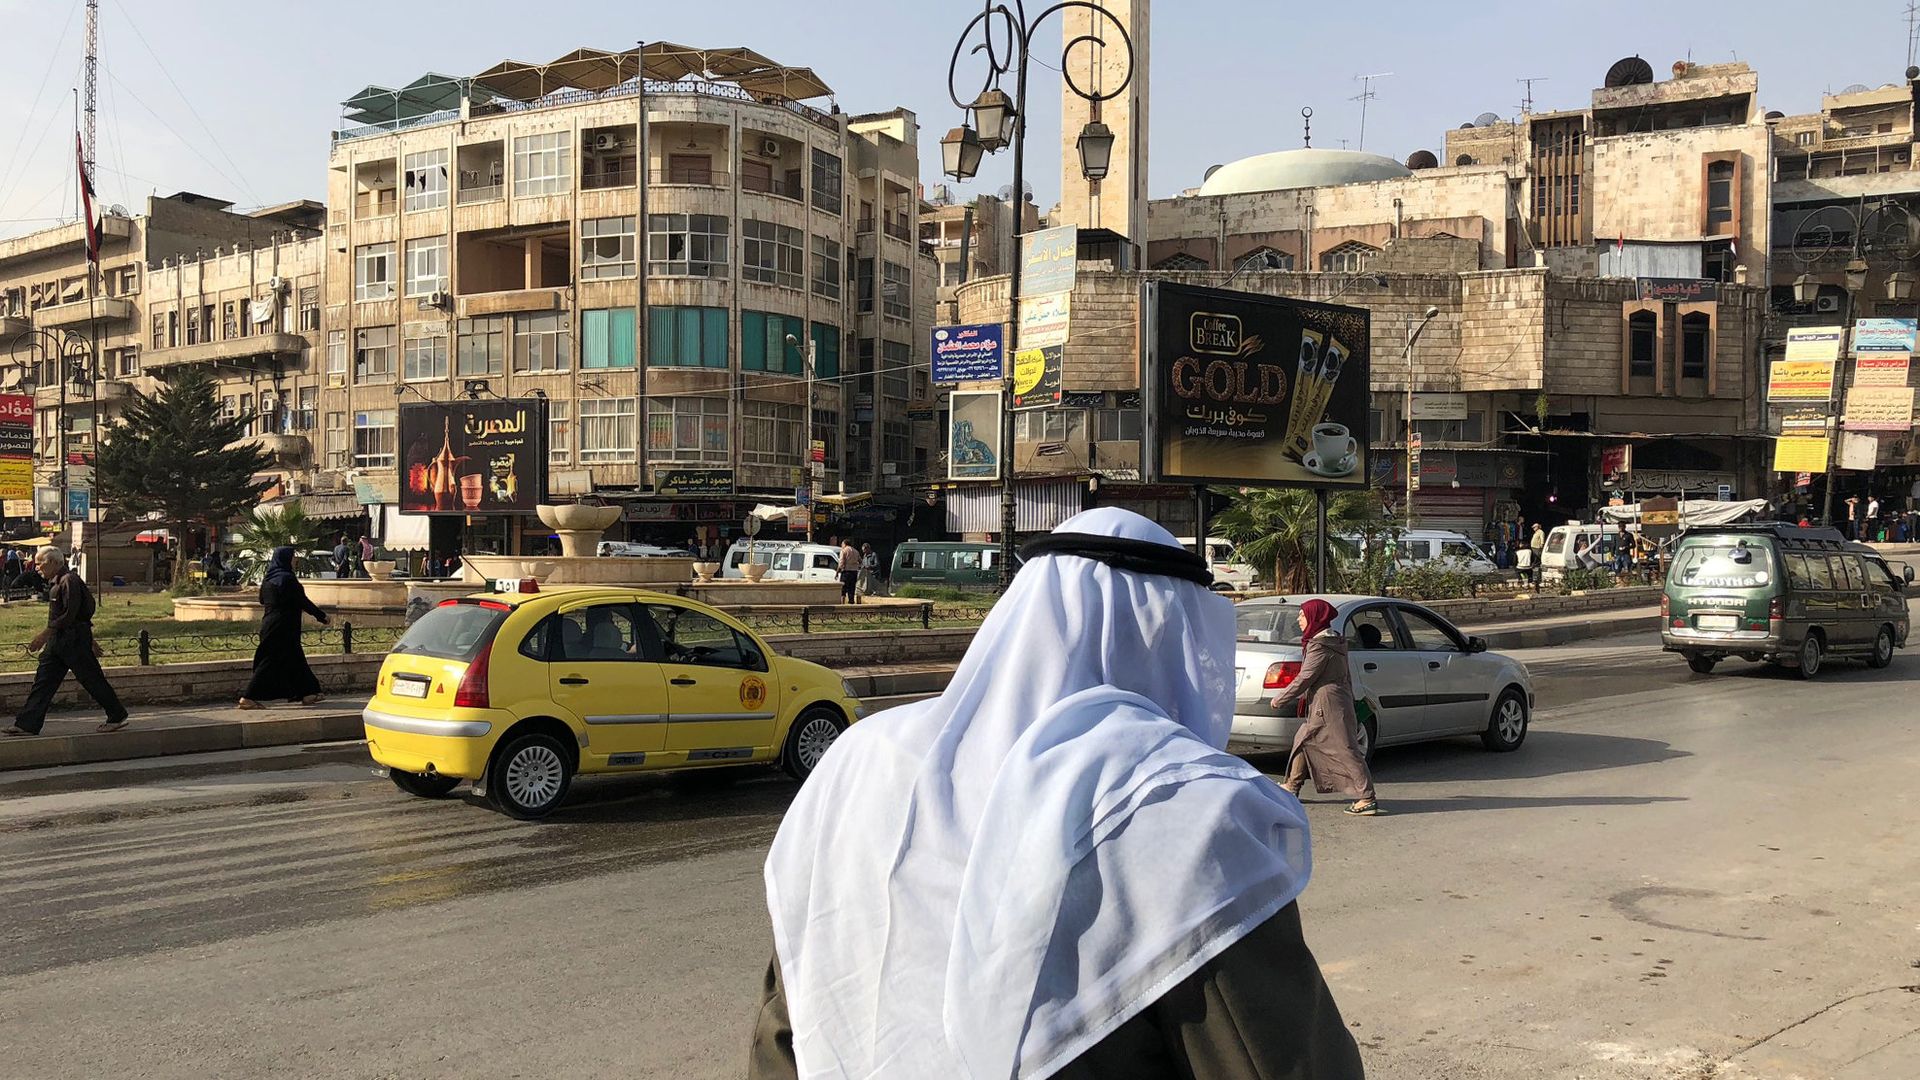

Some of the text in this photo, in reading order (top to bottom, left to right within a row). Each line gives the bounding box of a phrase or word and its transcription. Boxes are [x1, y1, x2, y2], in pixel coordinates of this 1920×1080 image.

[1203, 319, 1227, 332] Coffee
[1196, 327, 1236, 347] BREAK
[1773, 368, 1791, 377] باشا
[1812, 368, 1831, 377] عامر
[1172, 356, 1287, 404] GOLD
[0, 400, 32, 417] فؤاد
[1186, 404, 1224, 425] بريك
[464, 410, 526, 438] المصرية
[0, 431, 31, 440] لخدمات
[668, 474, 732, 487] محمود أحمد شاكر
[499, 580, 516, 592] ٦٥١
[1687, 598, 1748, 607] HYUNDAI
